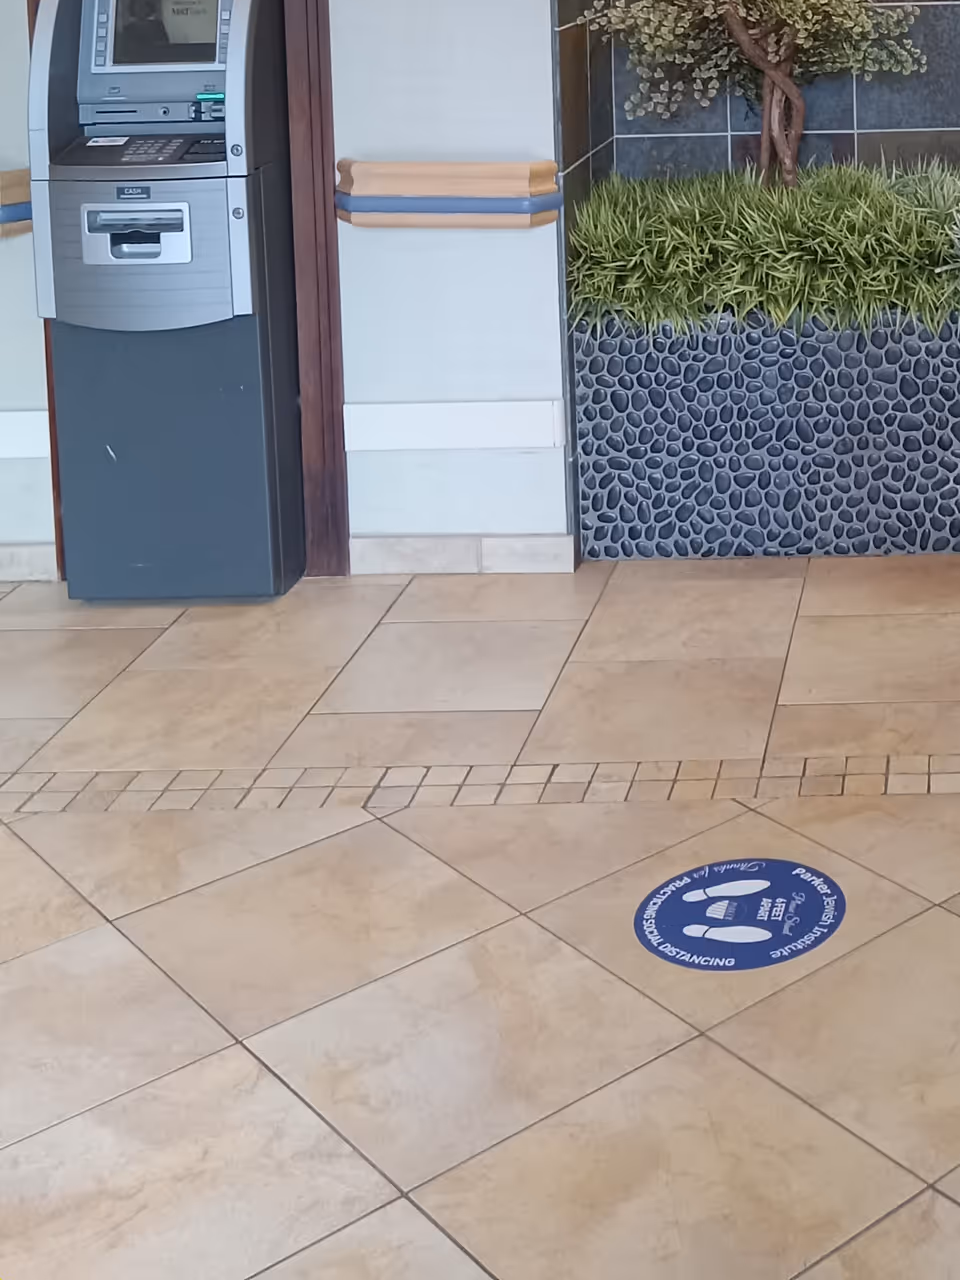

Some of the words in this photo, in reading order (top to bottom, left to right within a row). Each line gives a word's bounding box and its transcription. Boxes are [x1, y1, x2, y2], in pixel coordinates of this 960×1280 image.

[124, 187, 142, 195] CASH
[692, 865, 709, 879] for
[791, 867, 831, 895] Parker
[643, 876, 692, 919] PRACTICING
[756, 897, 773, 921] APART
[819, 895, 837, 925] Jewish
[770, 903, 786, 921] FEET
[642, 919, 664, 947] SOCIAL
[769, 926, 828, 958] Institute
[658, 942, 736, 967] DISTANCING
